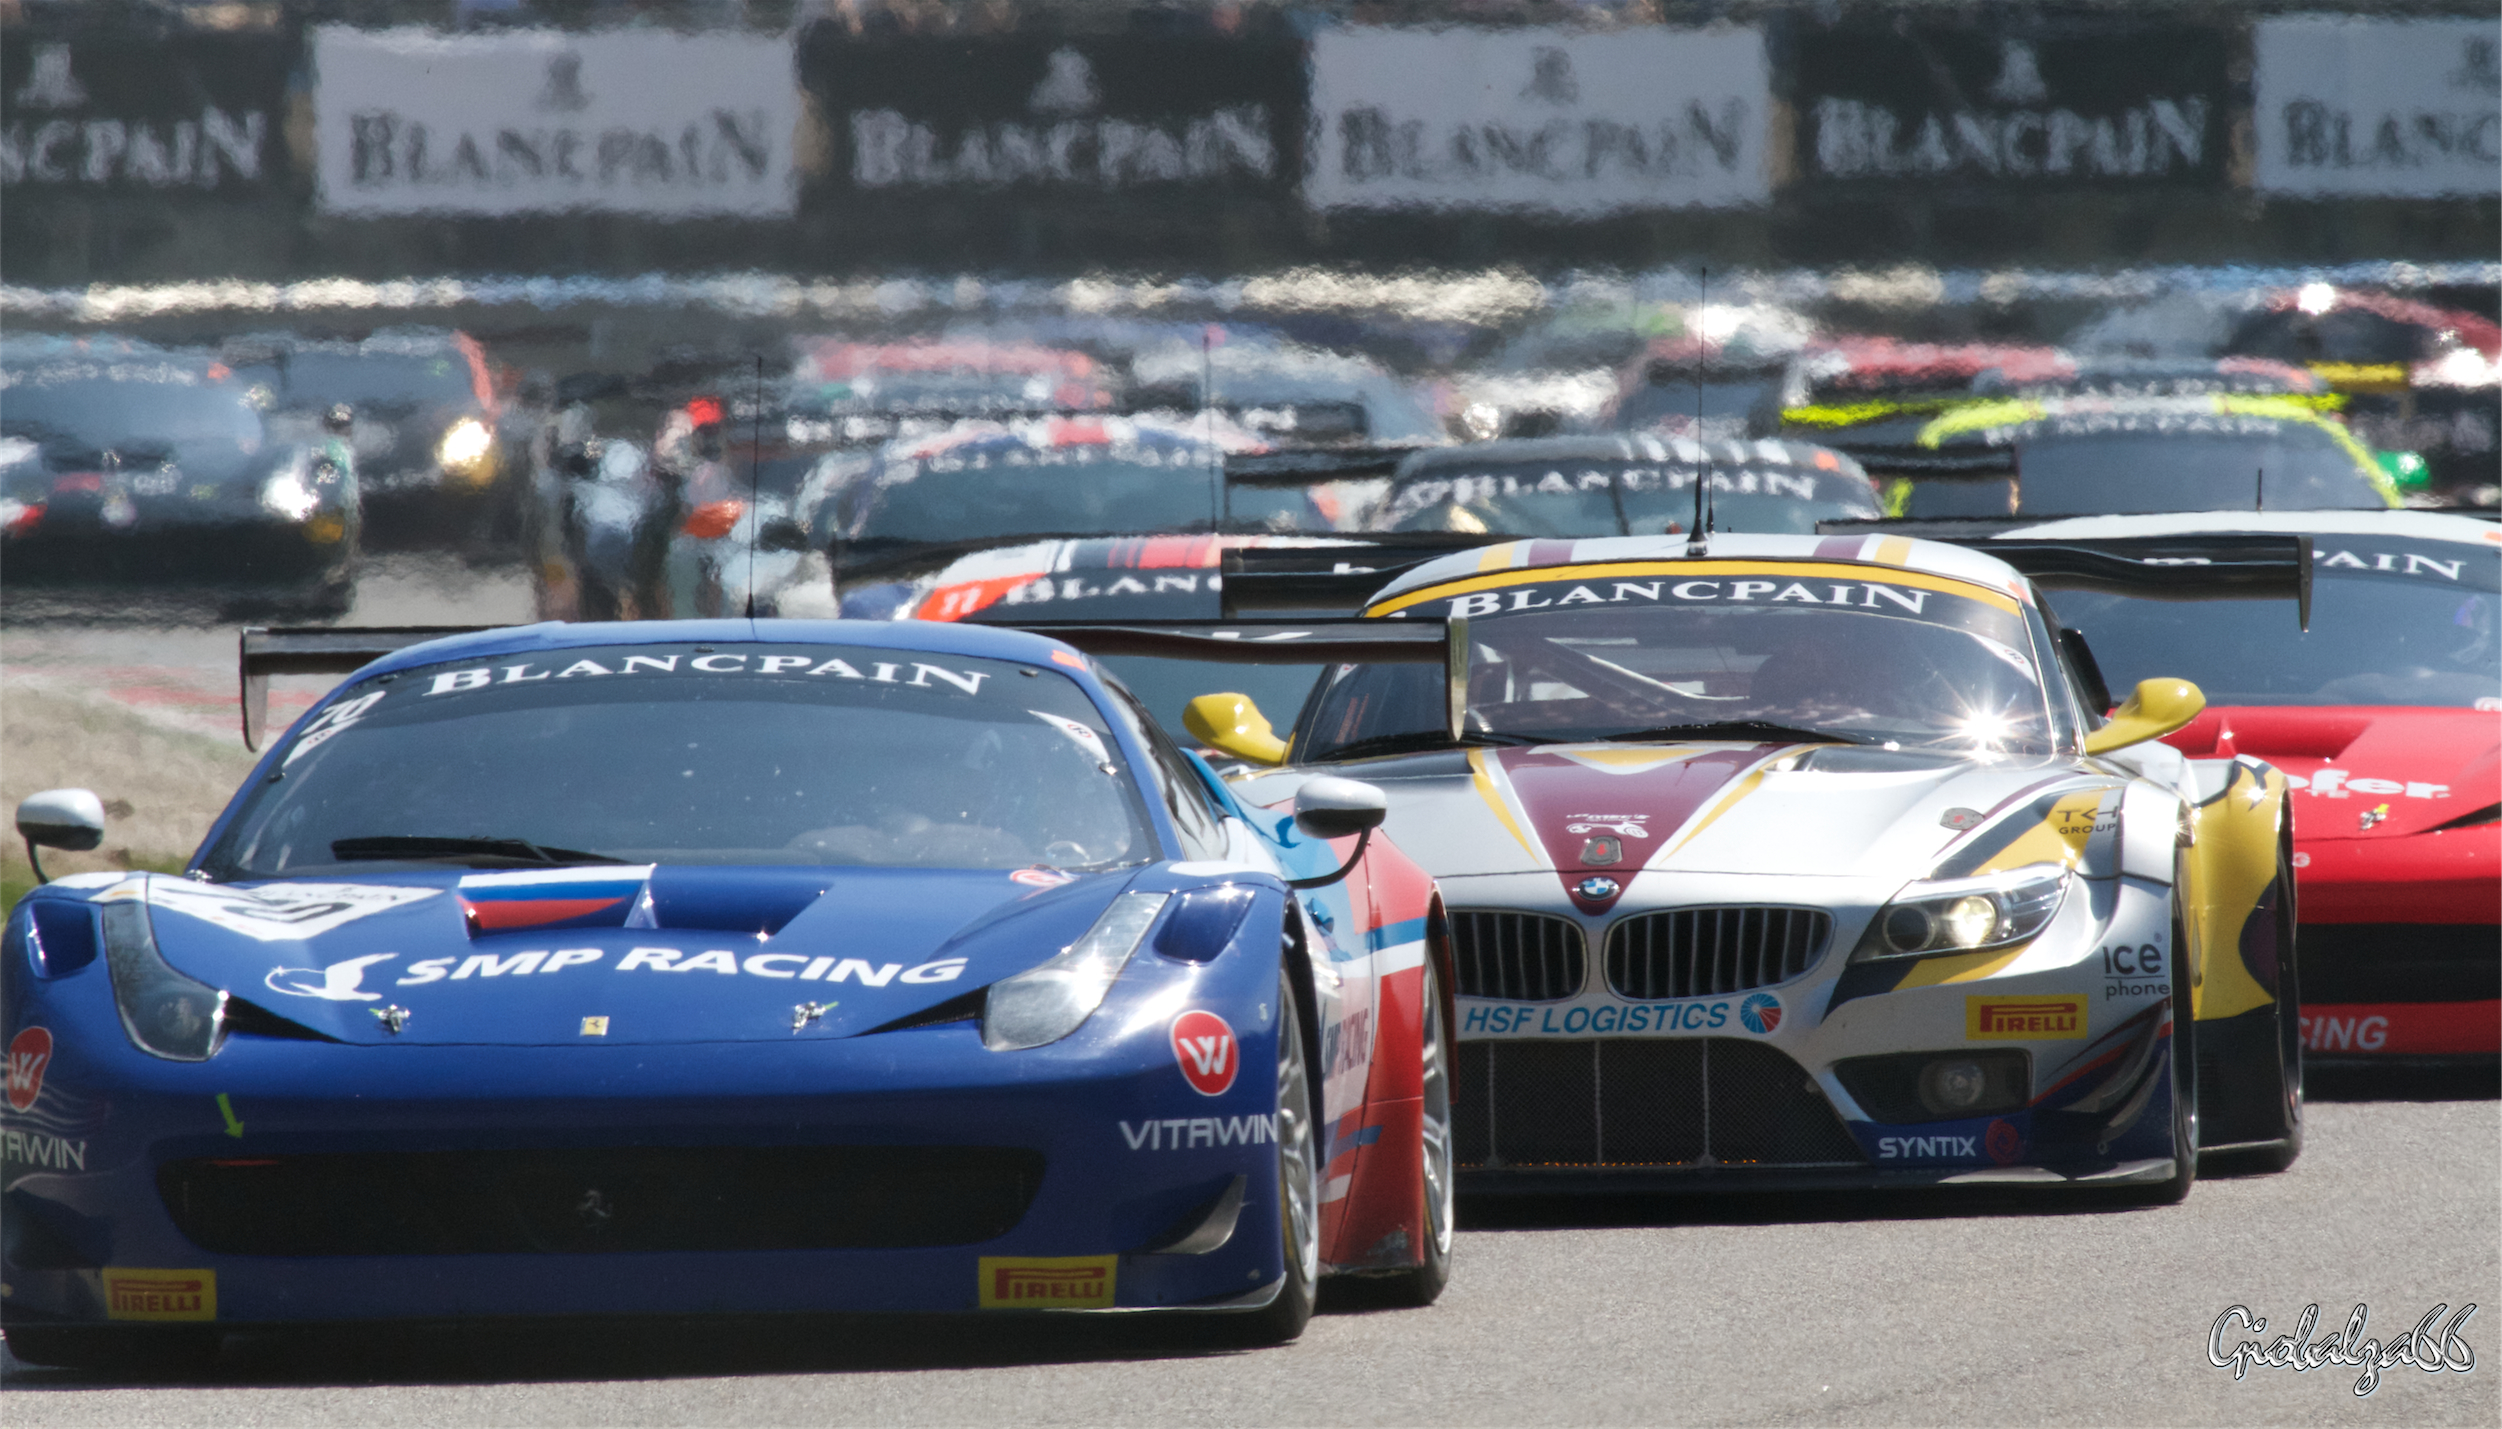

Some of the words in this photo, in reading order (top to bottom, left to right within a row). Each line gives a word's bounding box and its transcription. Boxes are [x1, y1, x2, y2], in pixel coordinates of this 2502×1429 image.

[350, 108, 771, 186] BLANCPAIN
[852, 103, 1278, 189] BLANCPAIN
[1339, 97, 1750, 182] BLANCPAIN
[1814, 95, 2204, 177] BLANCPAIN
[1446, 579, 1932, 617] BLANCPAIN
[422, 652, 991, 697] BLANCPAIN
[2058, 823, 2117, 835] GROUP
[396, 947, 604, 986] SMP
[615, 946, 969, 988] RACING
[2105, 979, 2171, 1001] phone
[1463, 1005, 1534, 1034] HSF
[1541, 1000, 1730, 1034] LOGISTICS
[1980, 1002, 2078, 1033] PIRELLI
[1118, 1112, 1279, 1151] VITAWIN
[1877, 1135, 1978, 1159] SYNTIX
[111, 1279, 202, 1313] PIRELLI
[995, 1266, 1106, 1300] PIRELLI
